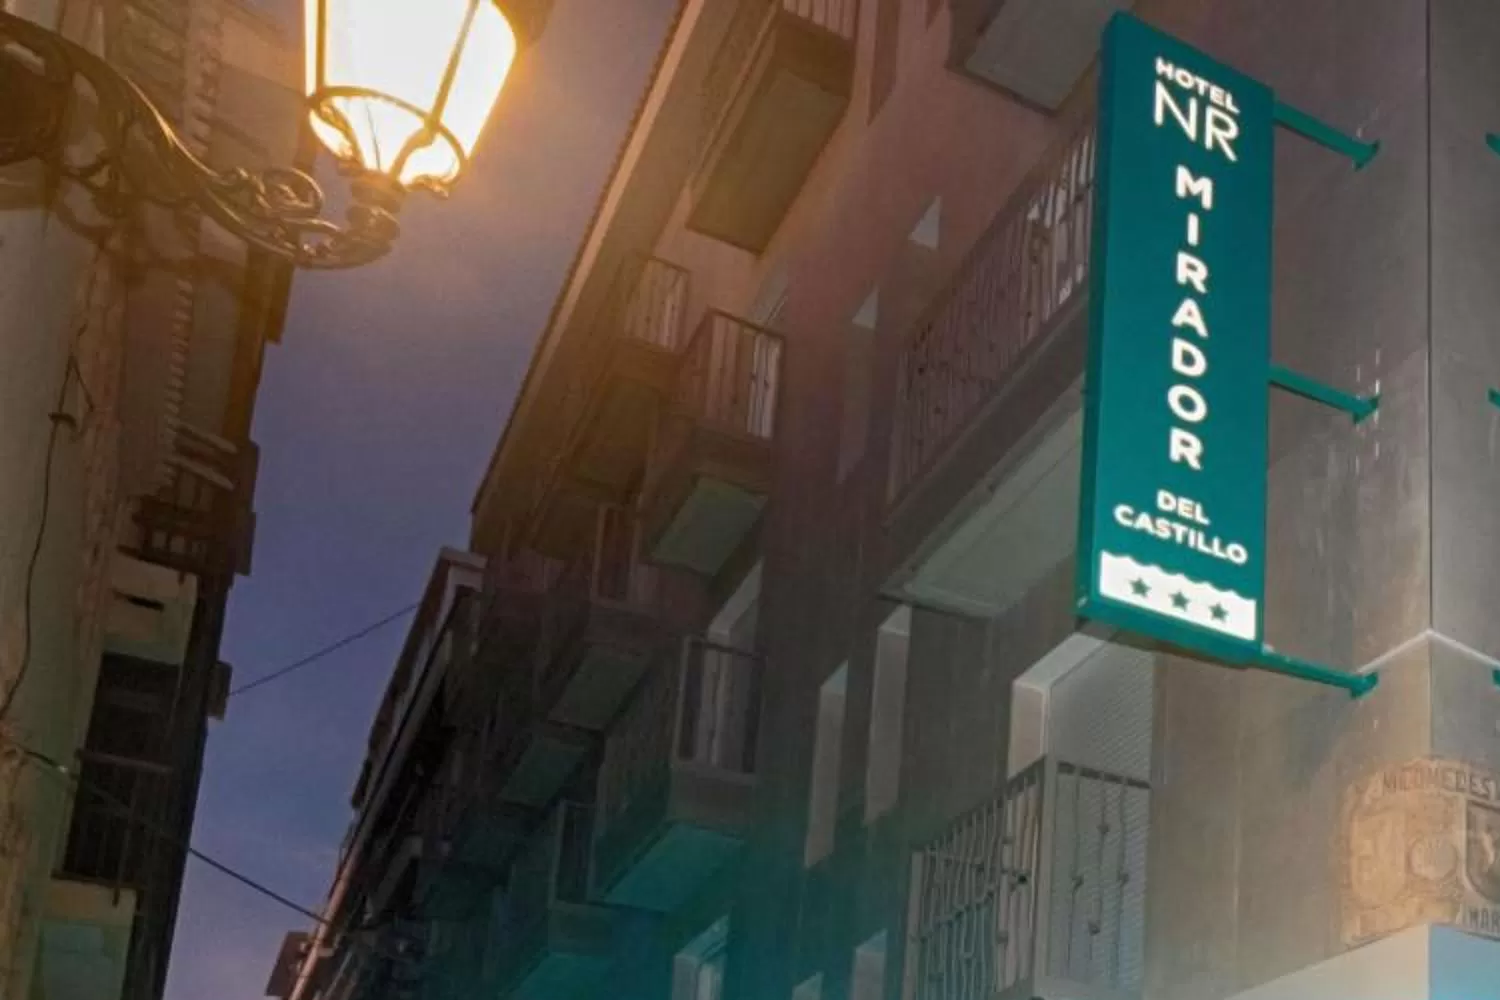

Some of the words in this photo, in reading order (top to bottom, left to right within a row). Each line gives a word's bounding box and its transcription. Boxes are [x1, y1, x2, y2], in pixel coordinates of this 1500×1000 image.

[1154, 56, 1240, 114] HOTEL
[1153, 80, 1240, 162] NR
[1166, 164, 1213, 471] MIRADOR
[1113, 503, 1249, 565] CASTILLO
[1156, 489, 1210, 525] DEL
